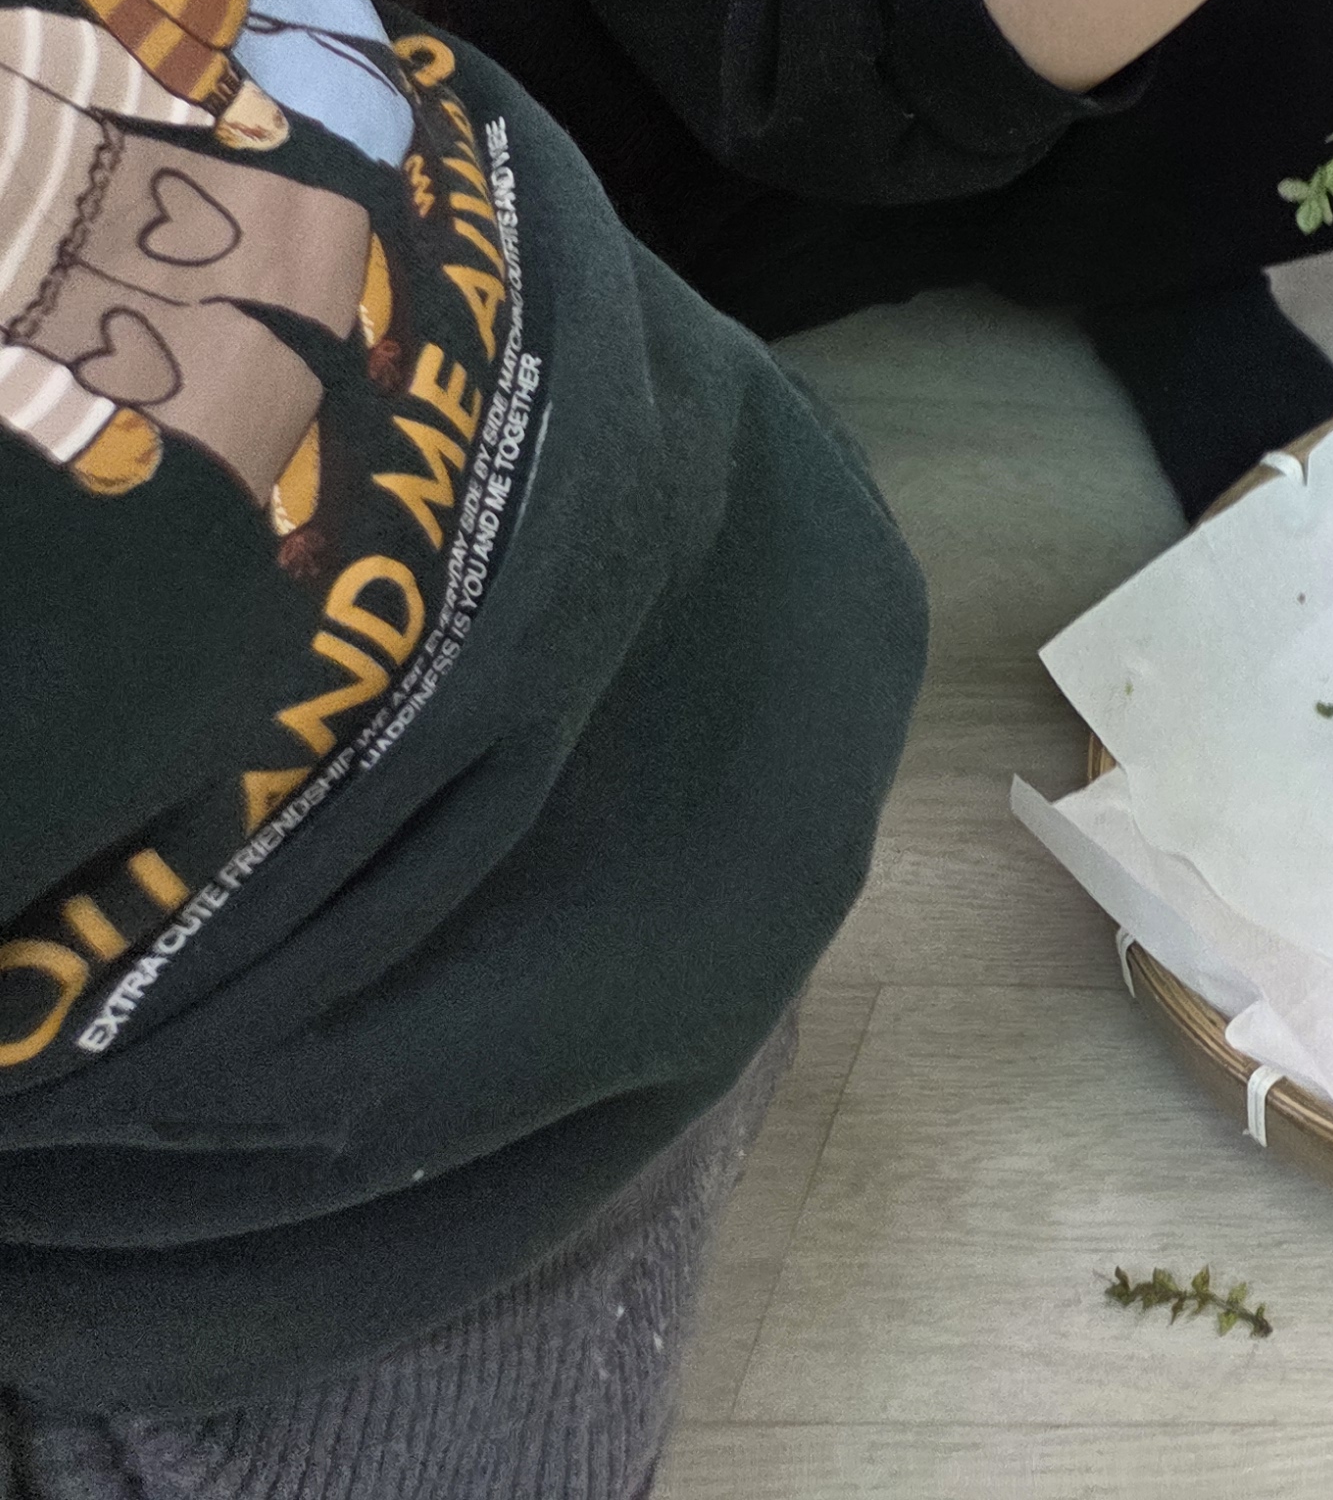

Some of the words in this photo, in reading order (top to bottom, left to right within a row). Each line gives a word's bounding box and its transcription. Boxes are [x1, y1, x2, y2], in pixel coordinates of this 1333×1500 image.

[494, 352, 542, 473] TOGETHER
[485, 467, 513, 512] ME
[474, 509, 500, 563] AND
[241, 554, 428, 839] AND
[371, 342, 484, 552] ME
[461, 551, 488, 611] YOU
[450, 609, 472, 639] IS
[76, 954, 171, 1053] EXTRA
[158, 884, 230, 954] CUTE
[220, 747, 355, 888] FRIENDSHIP
[459, 477, 483, 532] SIDE
[483, 392, 507, 444] SIDE
